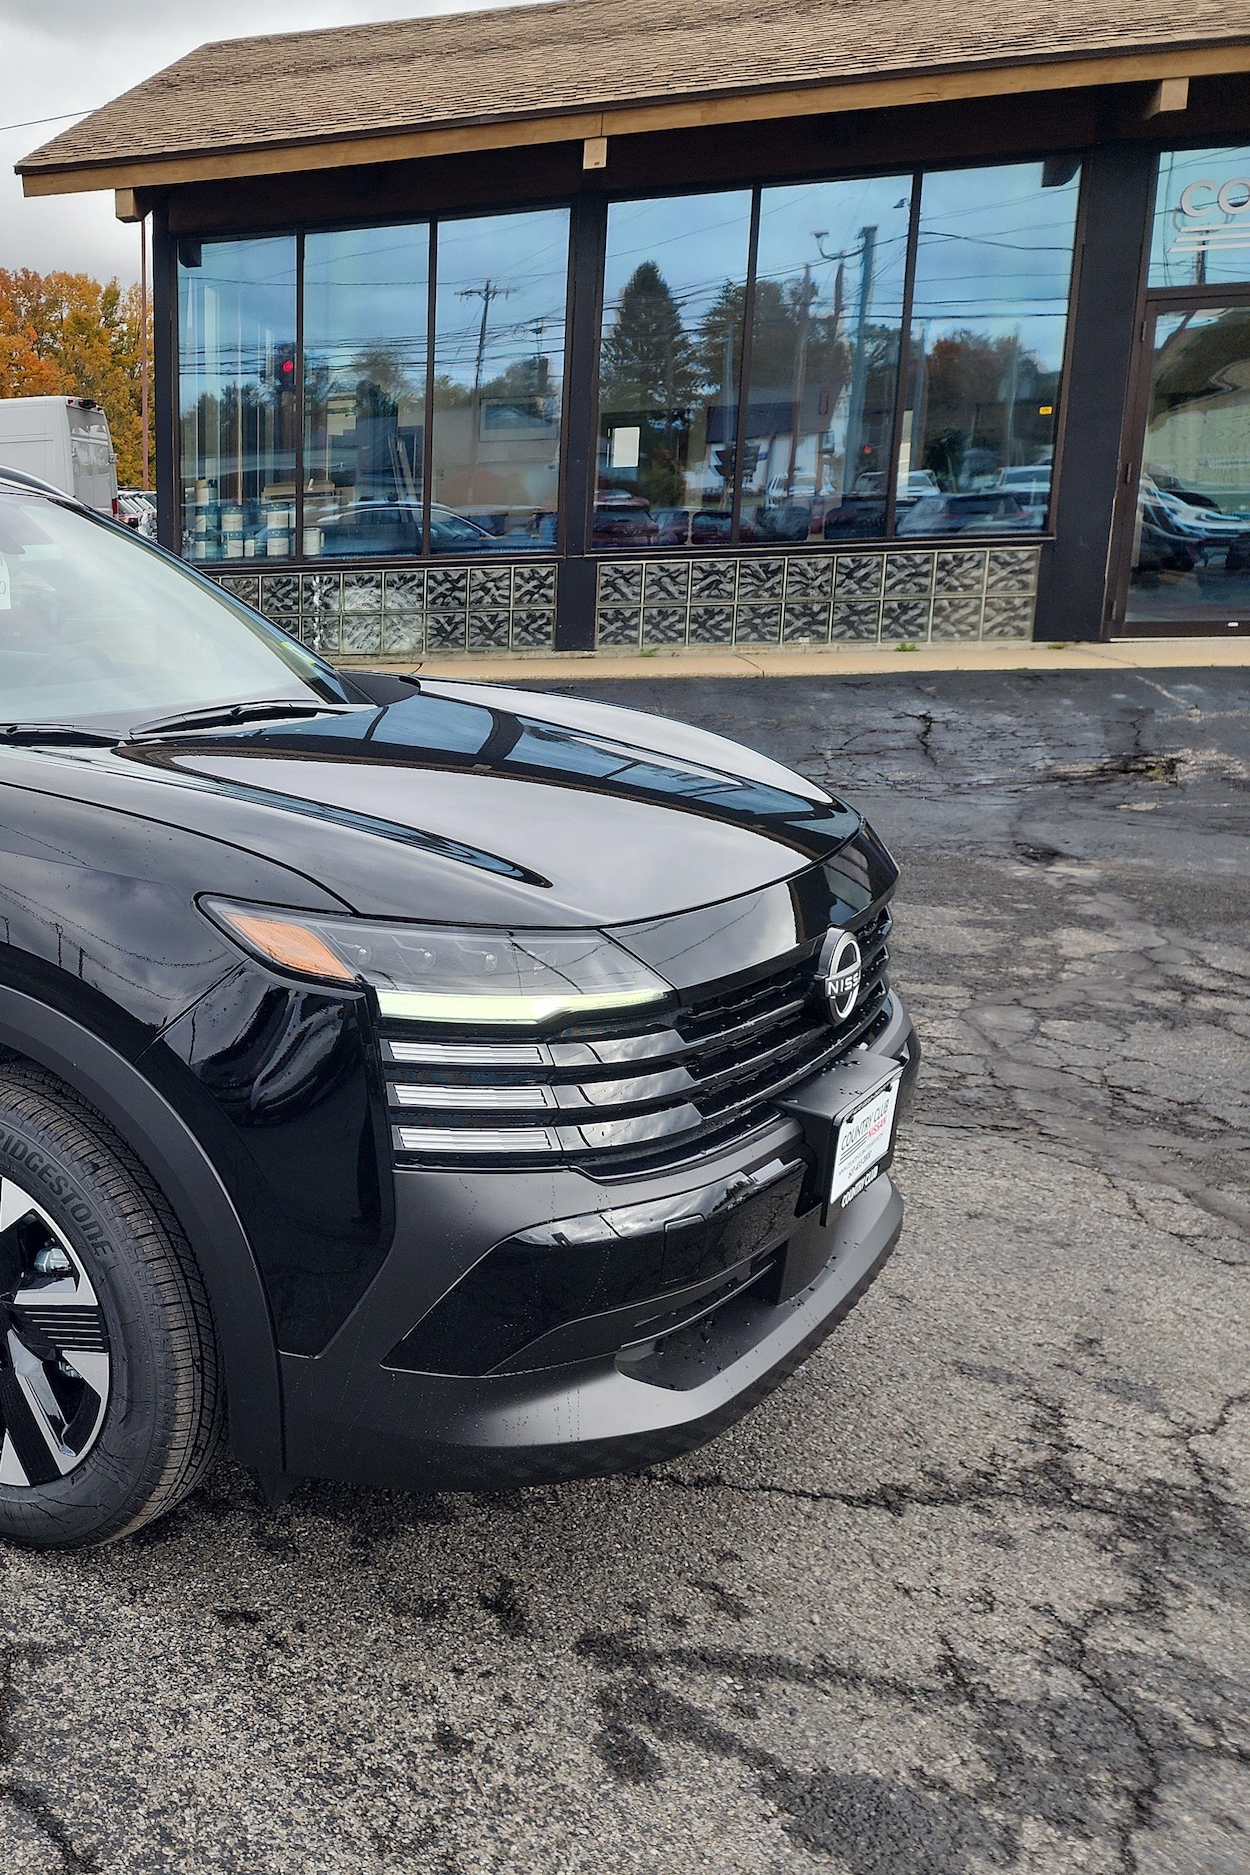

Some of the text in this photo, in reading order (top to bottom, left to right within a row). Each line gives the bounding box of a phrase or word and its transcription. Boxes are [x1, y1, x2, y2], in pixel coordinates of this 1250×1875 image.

[1180, 176, 1250, 218] CO
[841, 1099, 889, 1151] COUNTRY CLUB
